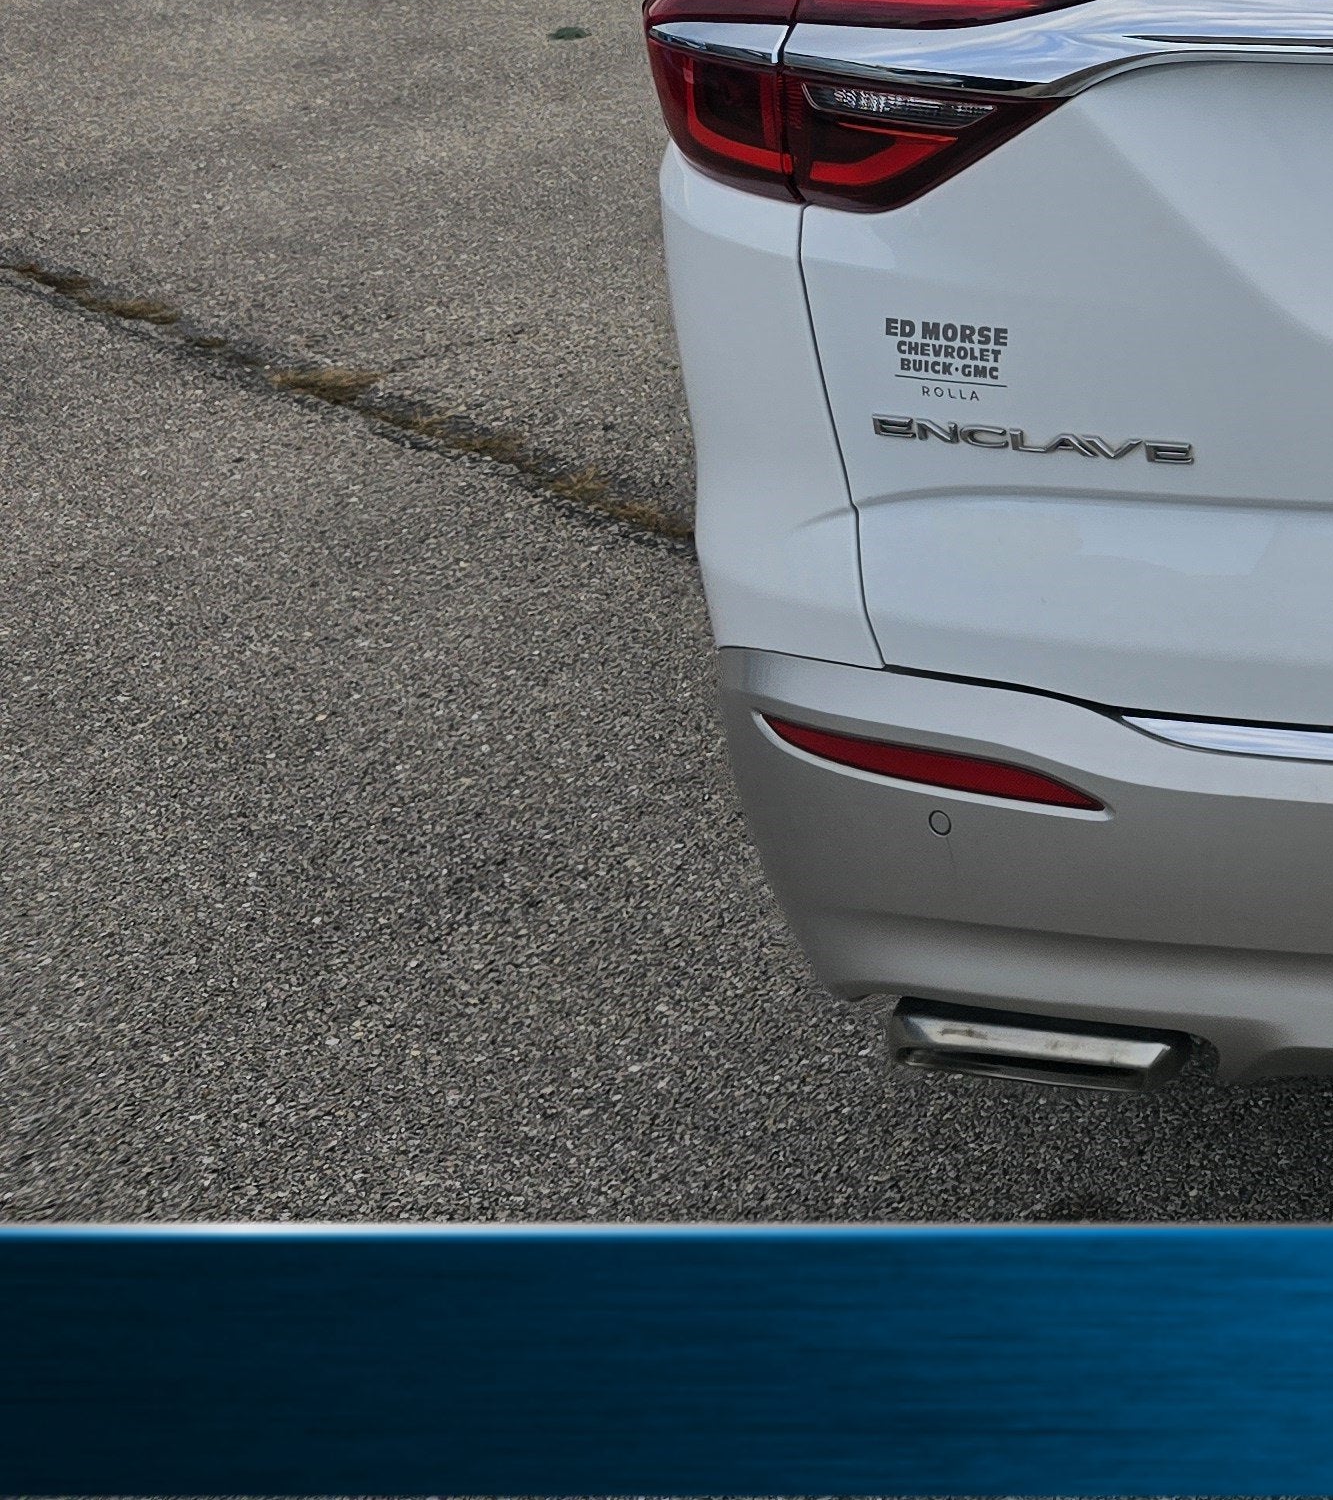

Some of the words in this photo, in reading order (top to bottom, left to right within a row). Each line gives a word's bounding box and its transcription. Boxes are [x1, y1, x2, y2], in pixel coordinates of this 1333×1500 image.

[885, 317, 916, 338] ED
[921, 321, 1009, 347] MORSE
[896, 340, 1002, 363] CHEVROLET
[921, 385, 980, 402] ROLLA
[871, 412, 1195, 466] ENCLAVE
